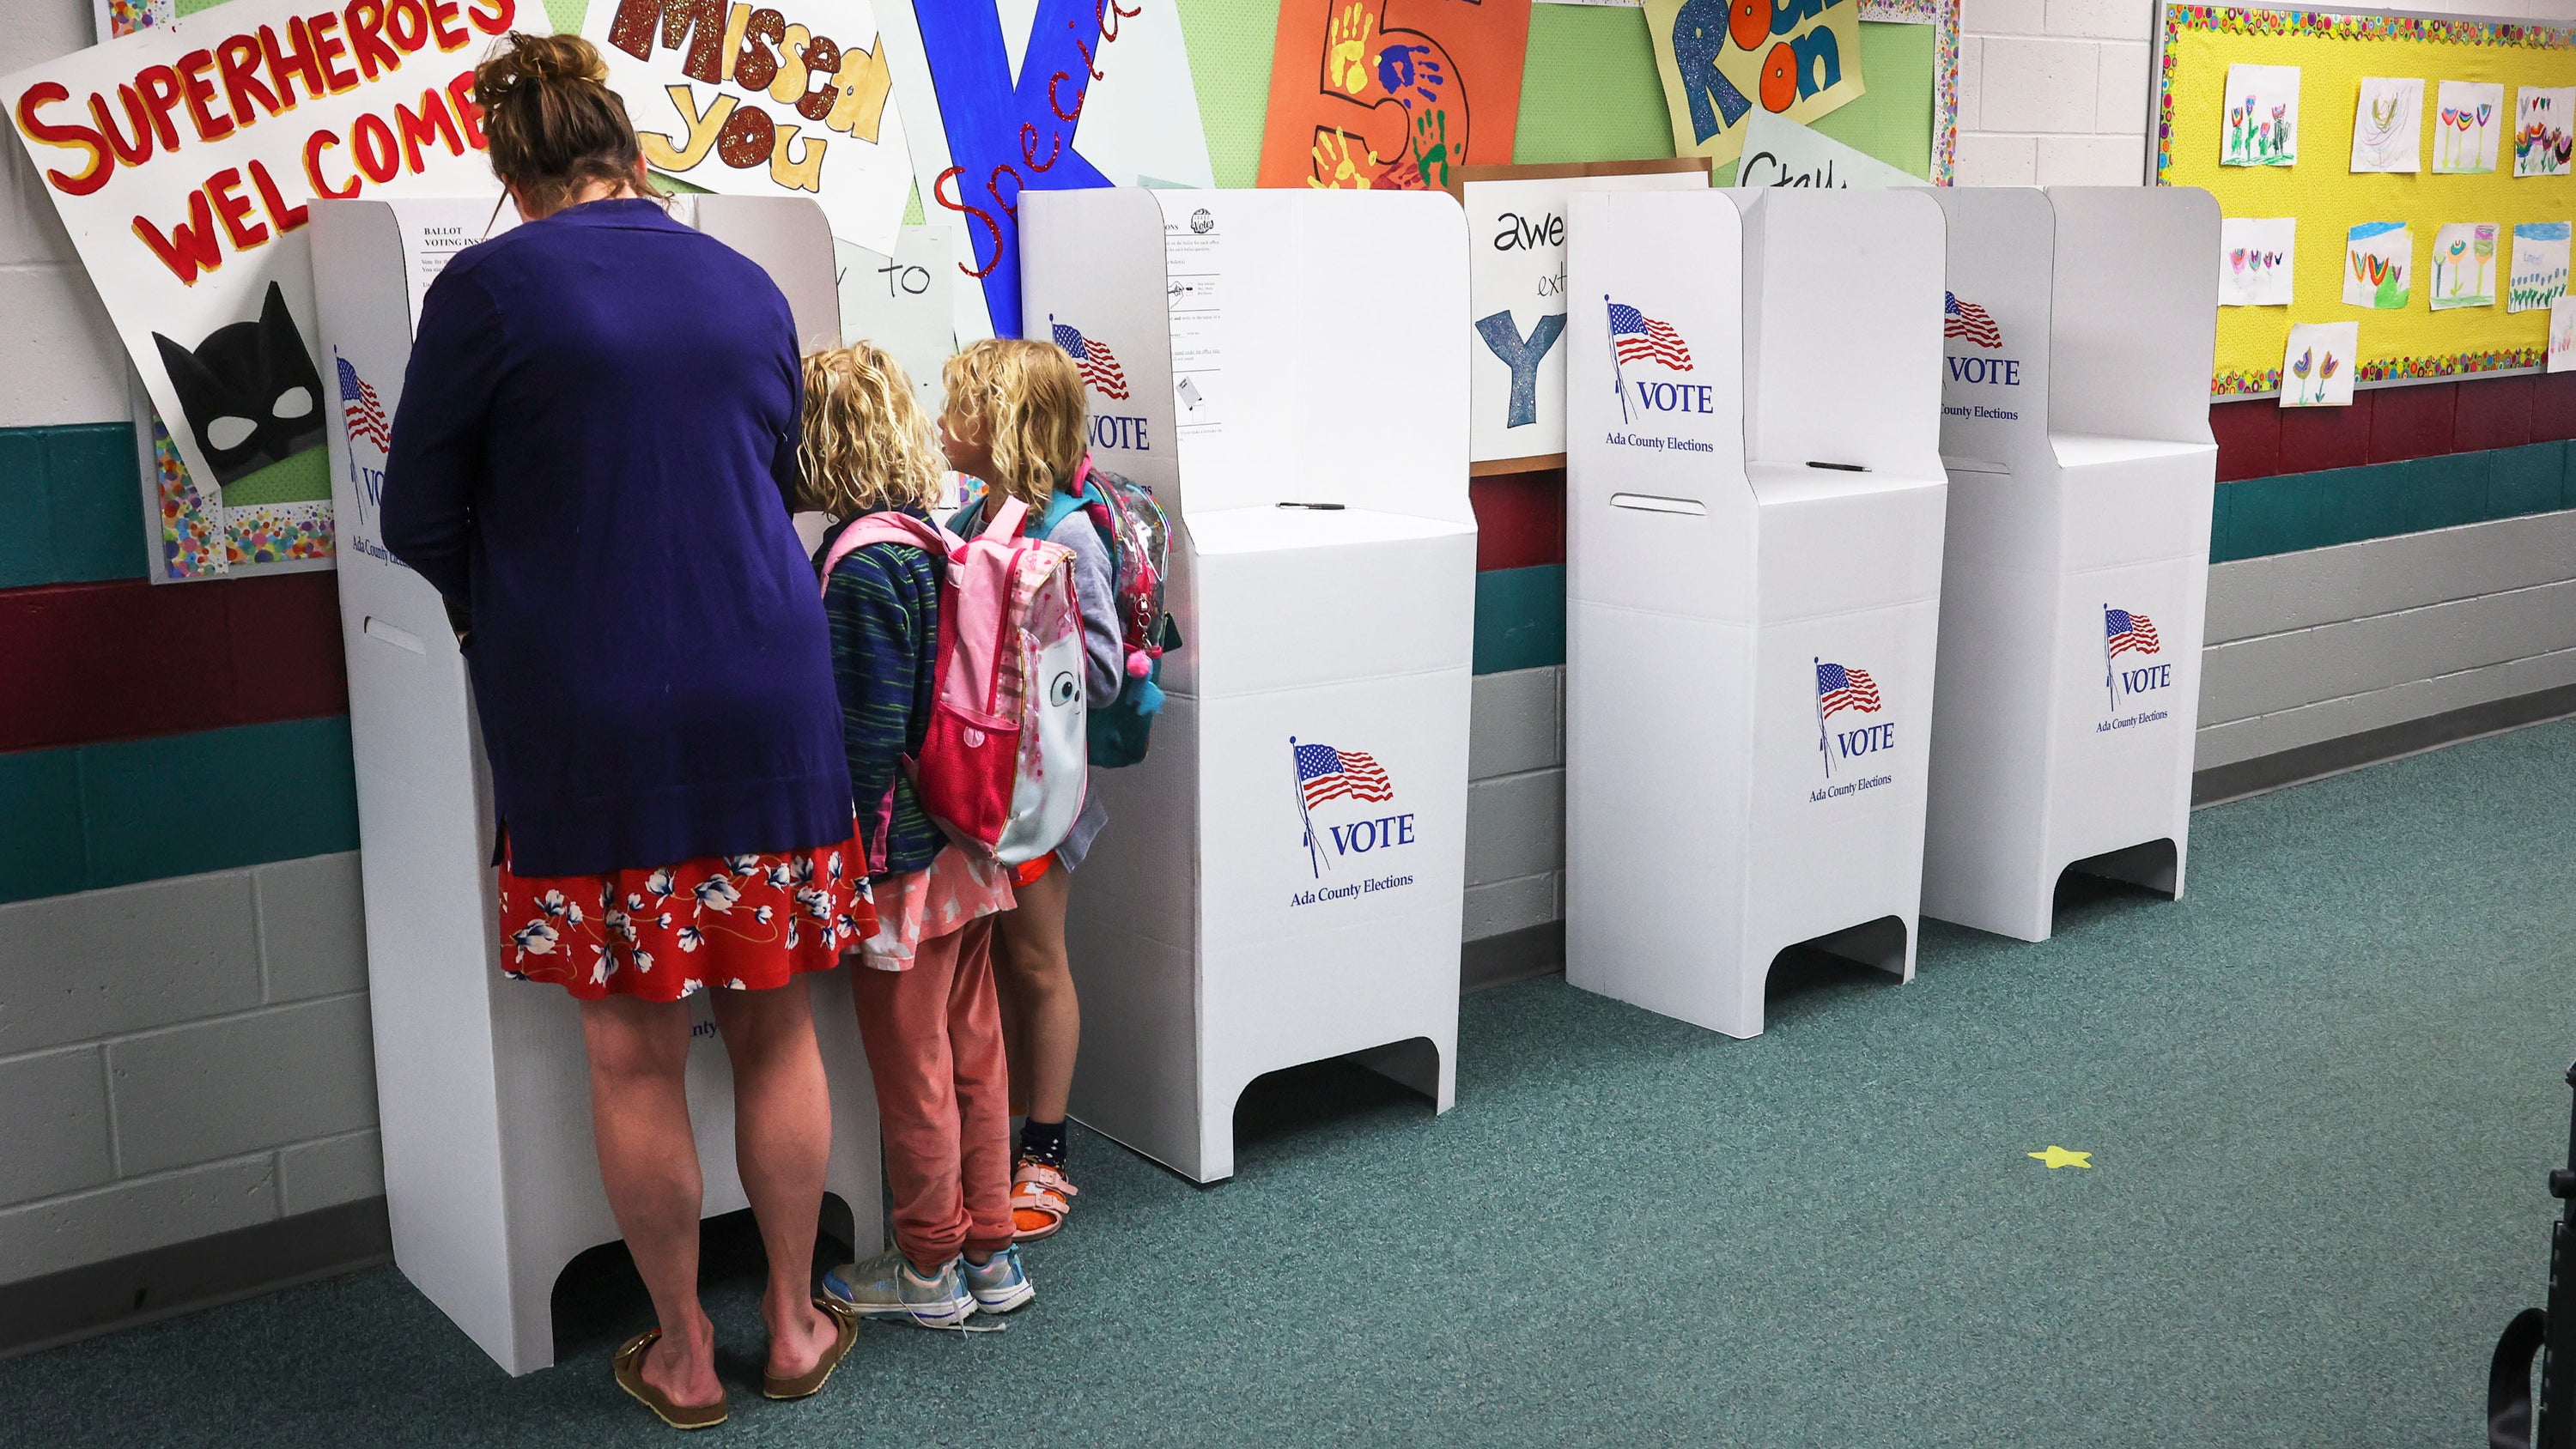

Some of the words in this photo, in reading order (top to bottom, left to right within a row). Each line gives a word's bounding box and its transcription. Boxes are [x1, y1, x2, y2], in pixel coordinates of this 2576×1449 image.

[131, 70, 489, 287] WELCOME
[424, 227, 463, 235] BALLOT
[425, 239, 462, 247] VOTING
[1494, 213, 1564, 251] awe
[1947, 356, 2020, 385] VOTE
[1636, 381, 1714, 414] VOTE
[1974, 406, 2019, 420] Elections
[1085, 415, 1150, 451] VOTE
[1606, 432, 1626, 446] Ada
[1628, 433, 1665, 452] County
[1668, 437, 1714, 452] Elections
[353, 535, 365, 553] Ada
[365, 539, 389, 567] County
[2122, 664, 2171, 694] VOTE
[2096, 720, 2111, 733] Ada
[2112, 716, 2137, 730] County
[2138, 710, 2168, 724] Elections
[1838, 722, 1894, 759] VOTE
[1809, 789, 1826, 803] Ada
[1827, 783, 1856, 797] County
[1858, 774, 1892, 791] Elections
[1329, 813, 1415, 856] VOTE
[1291, 890, 1315, 906] Ada
[1318, 883, 1361, 901] County
[1364, 874, 1413, 893] Elections
